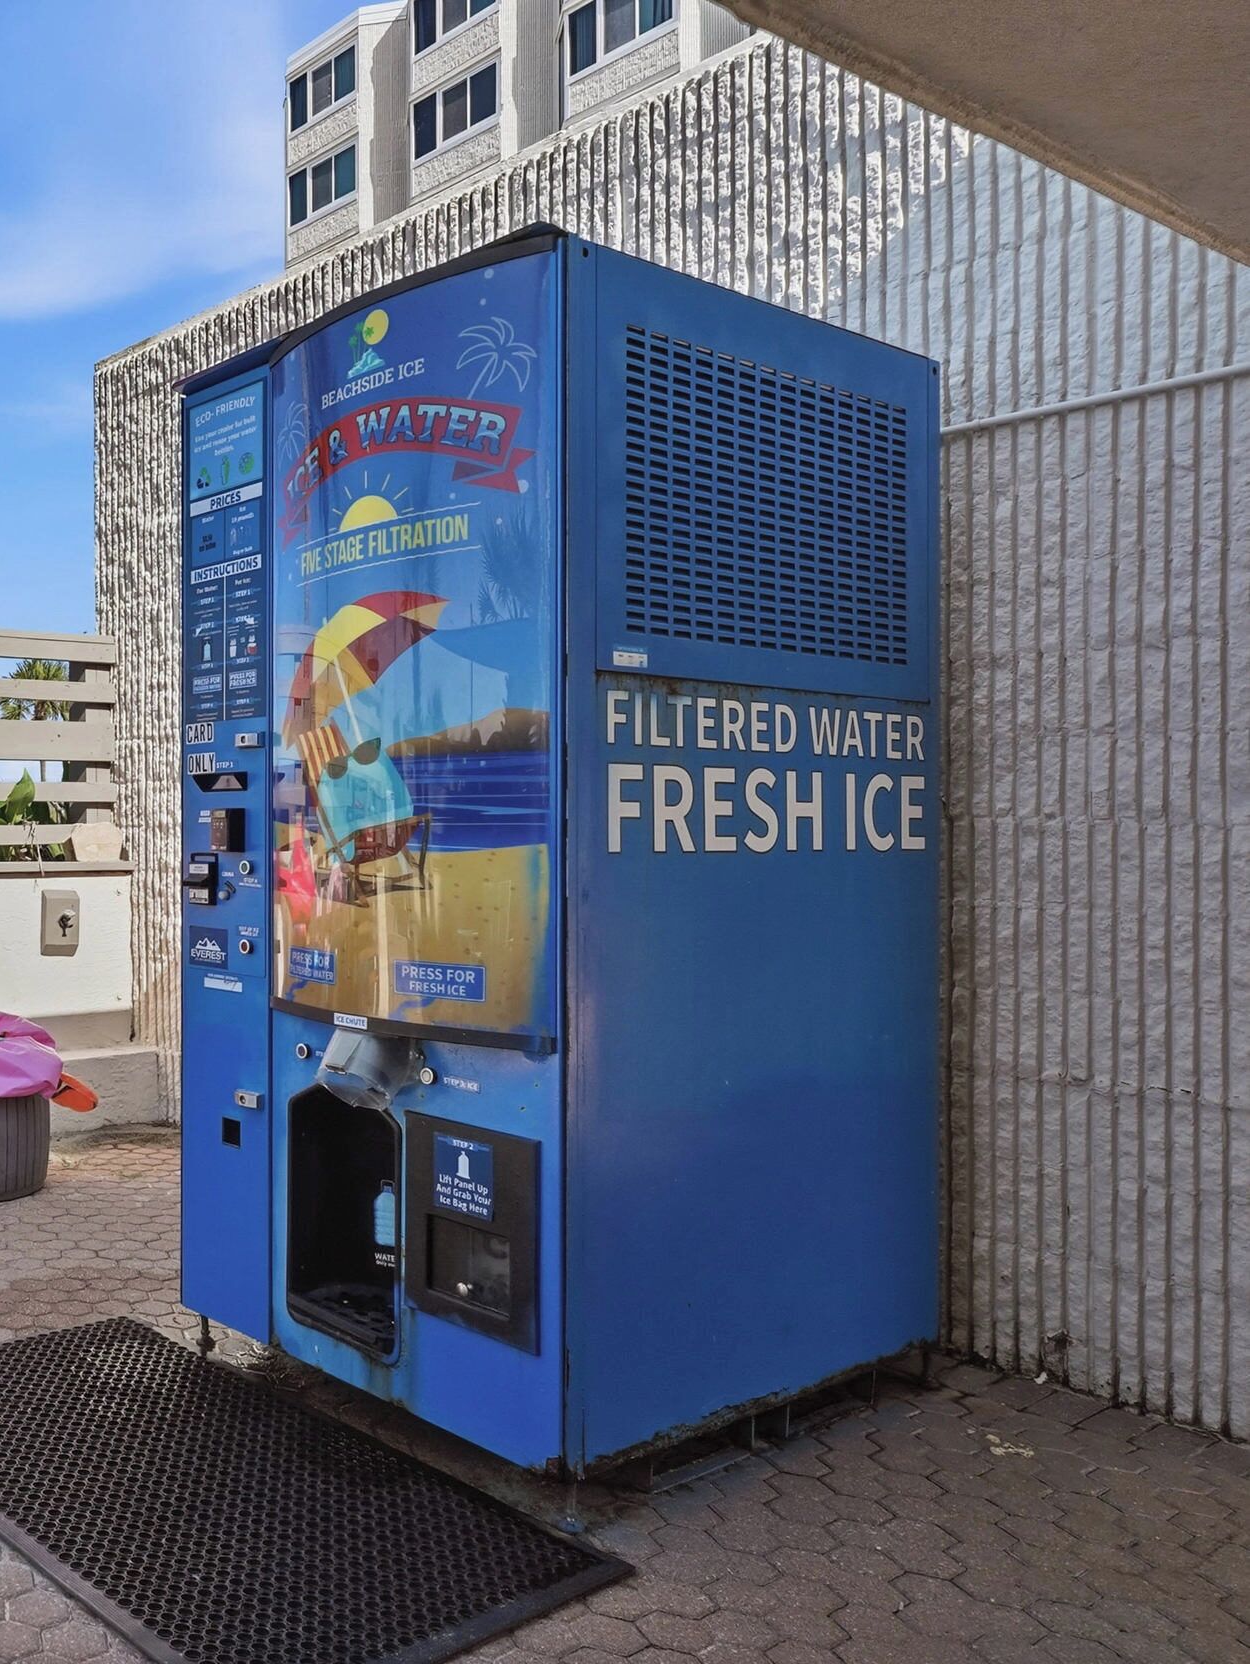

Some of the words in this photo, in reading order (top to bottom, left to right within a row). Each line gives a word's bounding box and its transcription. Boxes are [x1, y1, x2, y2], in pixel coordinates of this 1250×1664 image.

[321, 367, 395, 410] BEACHSIDE
[398, 358, 425, 381] ICE
[215, 396, 256, 416] FRIENDLY
[287, 446, 323, 497] ICE
[328, 428, 350, 467] &
[355, 403, 507, 455] WATER
[210, 491, 241, 509] PRICES
[301, 548, 322, 577] FIVE
[324, 533, 364, 569] STAGE
[368, 513, 468, 558] FILTRATION
[194, 556, 258, 582] INSTRUCTIONS
[187, 722, 213, 743] CARD
[606, 690, 797, 753] FILTERED
[809, 706, 925, 761] WATER
[188, 754, 215, 773] ONLY
[607, 763, 823, 853] FRESH
[845, 772, 926, 852] ICE
[191, 948, 227, 961] EVEREST
[291, 951, 313, 966] PRESS
[314, 954, 330, 969] FOR
[313, 970, 334, 981] WATER
[401, 965, 443, 982] PRESS
[447, 968, 476, 984] FOR
[409, 980, 445, 994] FRESH
[447, 984, 466, 997] ICE
[335, 1015, 346, 1025] ICE
[346, 1017, 367, 1028] CHUTE
[467, 1081, 479, 1092] ICE
[452, 1139, 469, 1149] STEP
[469, 1141, 474, 1150] 2
[439, 1173, 452, 1185] Lift
[454, 1177, 475, 1192] Panel
[477, 1183, 489, 1196] Up
[436, 1183, 451, 1195] And
[453, 1186, 472, 1200] Grab
[473, 1193, 492, 1206] Your
[439, 1195, 451, 1205] Ice
[452, 1198, 468, 1213] Bag
[469, 1203, 488, 1216] Here
[374, 1252, 396, 1263] WATE
